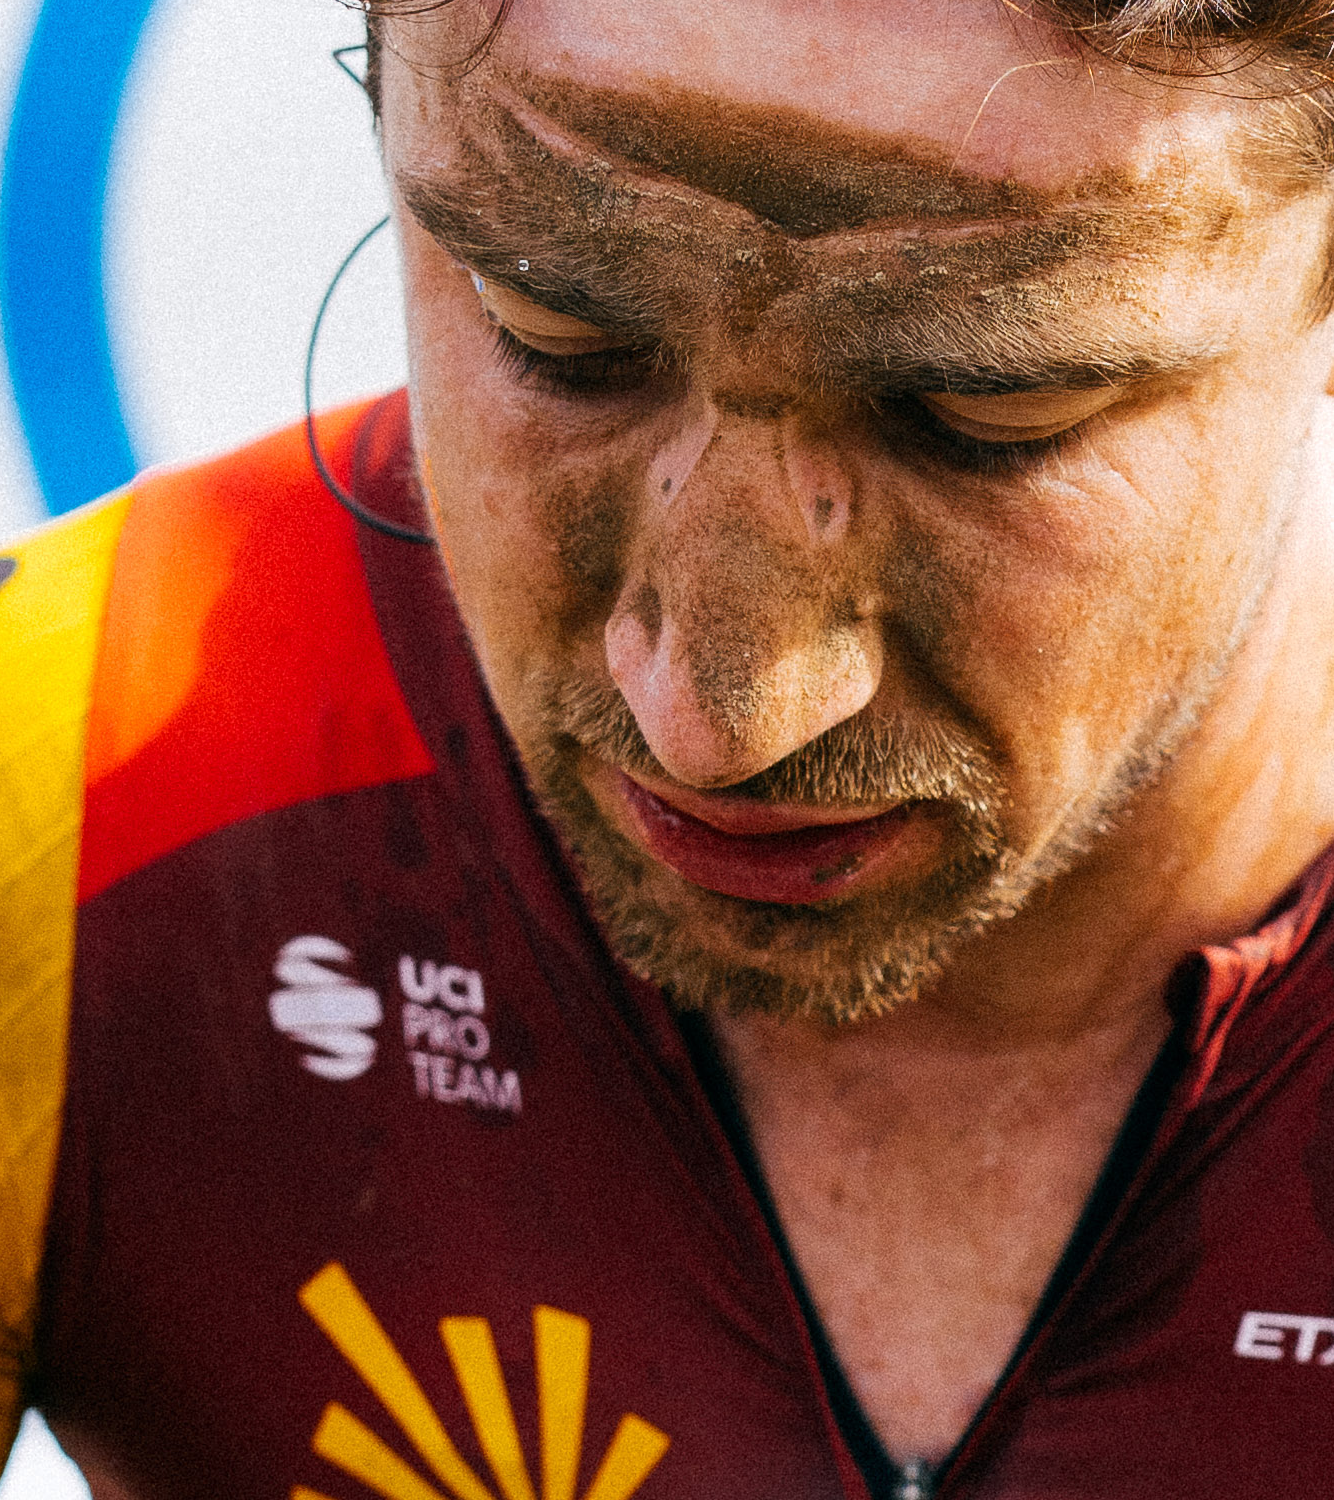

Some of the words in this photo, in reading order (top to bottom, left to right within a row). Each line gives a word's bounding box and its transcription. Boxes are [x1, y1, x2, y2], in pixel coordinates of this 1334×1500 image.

[398, 954, 486, 1014] UCI
[400, 1003, 491, 1061] PRO
[406, 1050, 523, 1115] TEAM
